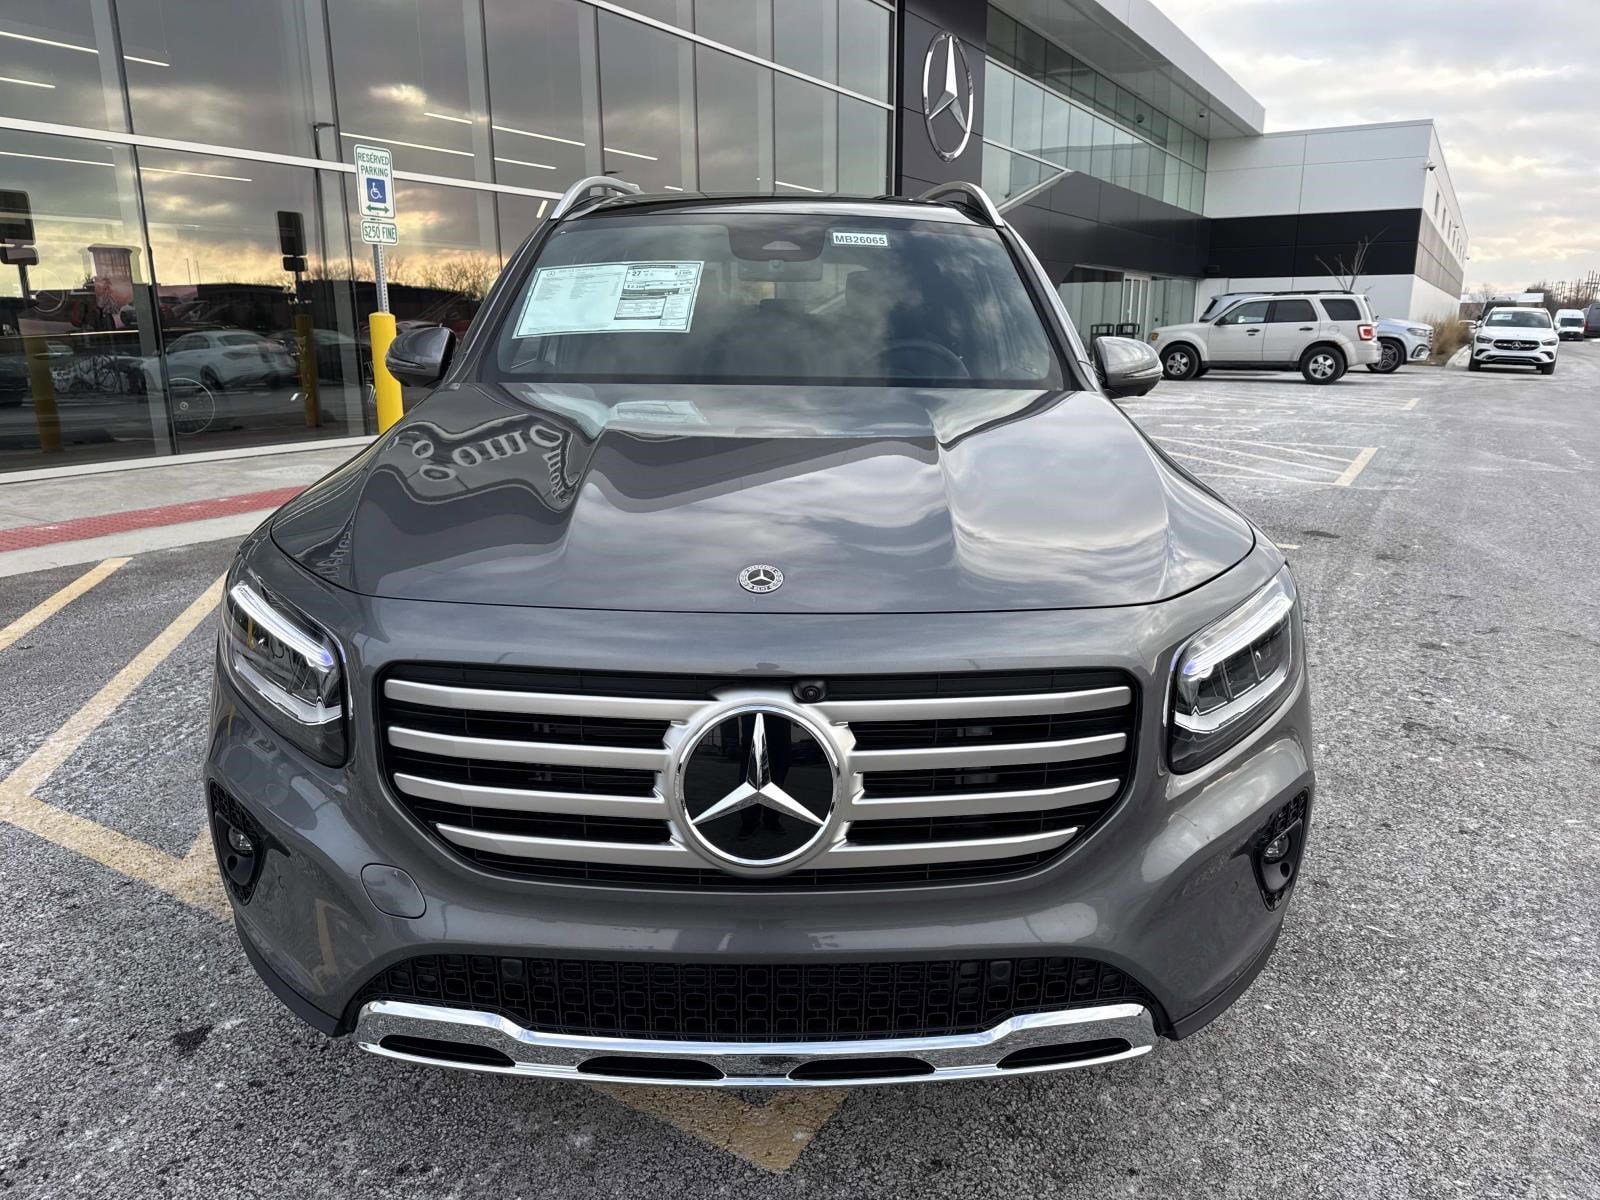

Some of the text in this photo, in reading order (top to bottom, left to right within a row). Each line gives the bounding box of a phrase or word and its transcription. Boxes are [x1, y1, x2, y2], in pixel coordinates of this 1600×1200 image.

[357, 152, 390, 165] RESERVED
[360, 165, 389, 177] PARKING
[364, 224, 396, 240] $250 FINE
[835, 235, 885, 245] MB26065
